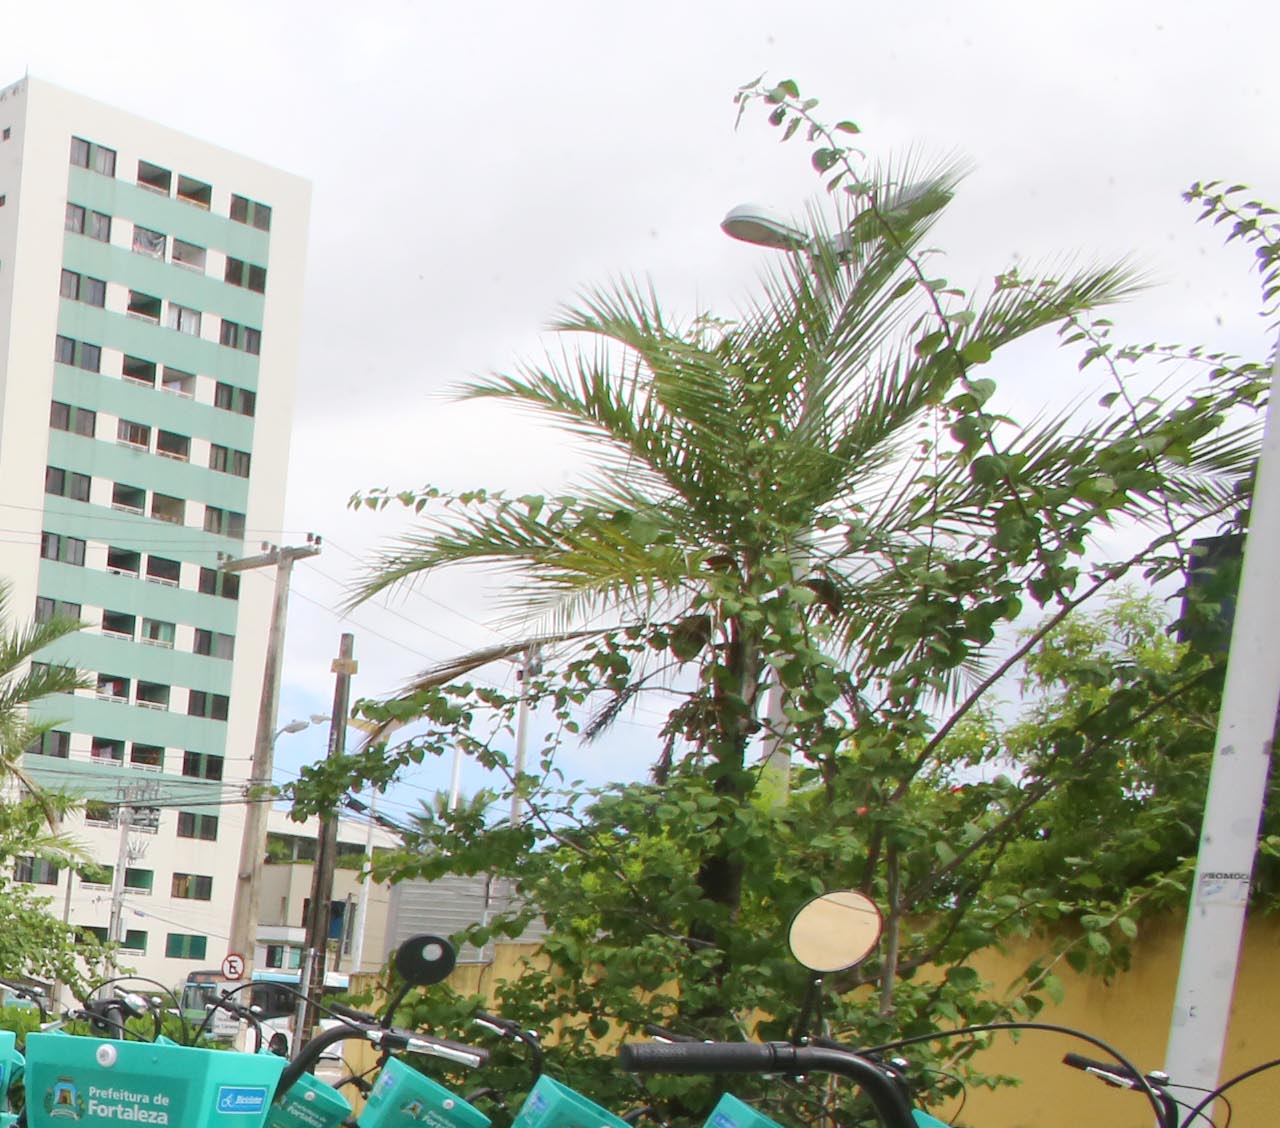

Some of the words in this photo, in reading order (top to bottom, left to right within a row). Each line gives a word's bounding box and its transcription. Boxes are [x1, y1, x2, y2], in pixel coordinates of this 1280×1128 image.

[89, 1086, 149, 1104] Prefeitura
[153, 1093, 170, 1107] de
[88, 1101, 169, 1126] Fortaleza
[288, 1106, 323, 1128] Fortaleza
